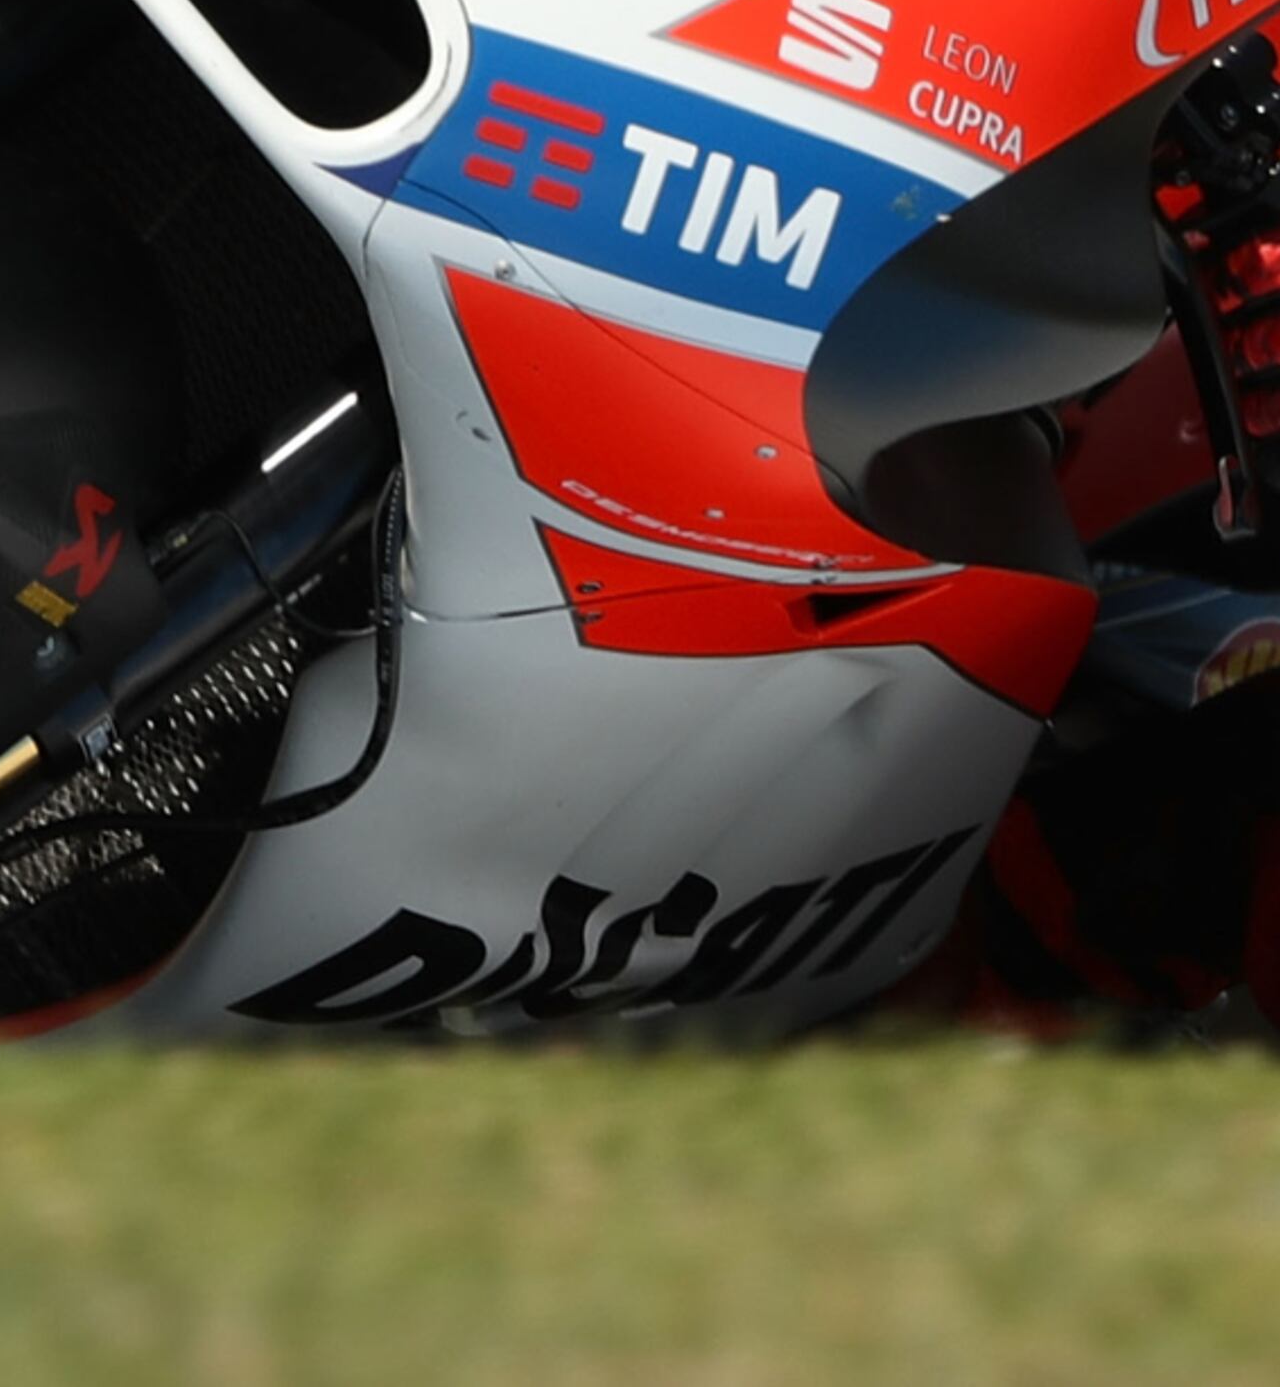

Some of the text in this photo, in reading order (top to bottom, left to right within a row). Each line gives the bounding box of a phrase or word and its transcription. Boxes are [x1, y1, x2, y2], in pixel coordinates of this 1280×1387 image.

[923, 24, 1017, 94] LEON
[907, 80, 1022, 164] CUPRA
[621, 123, 842, 291] TIM
